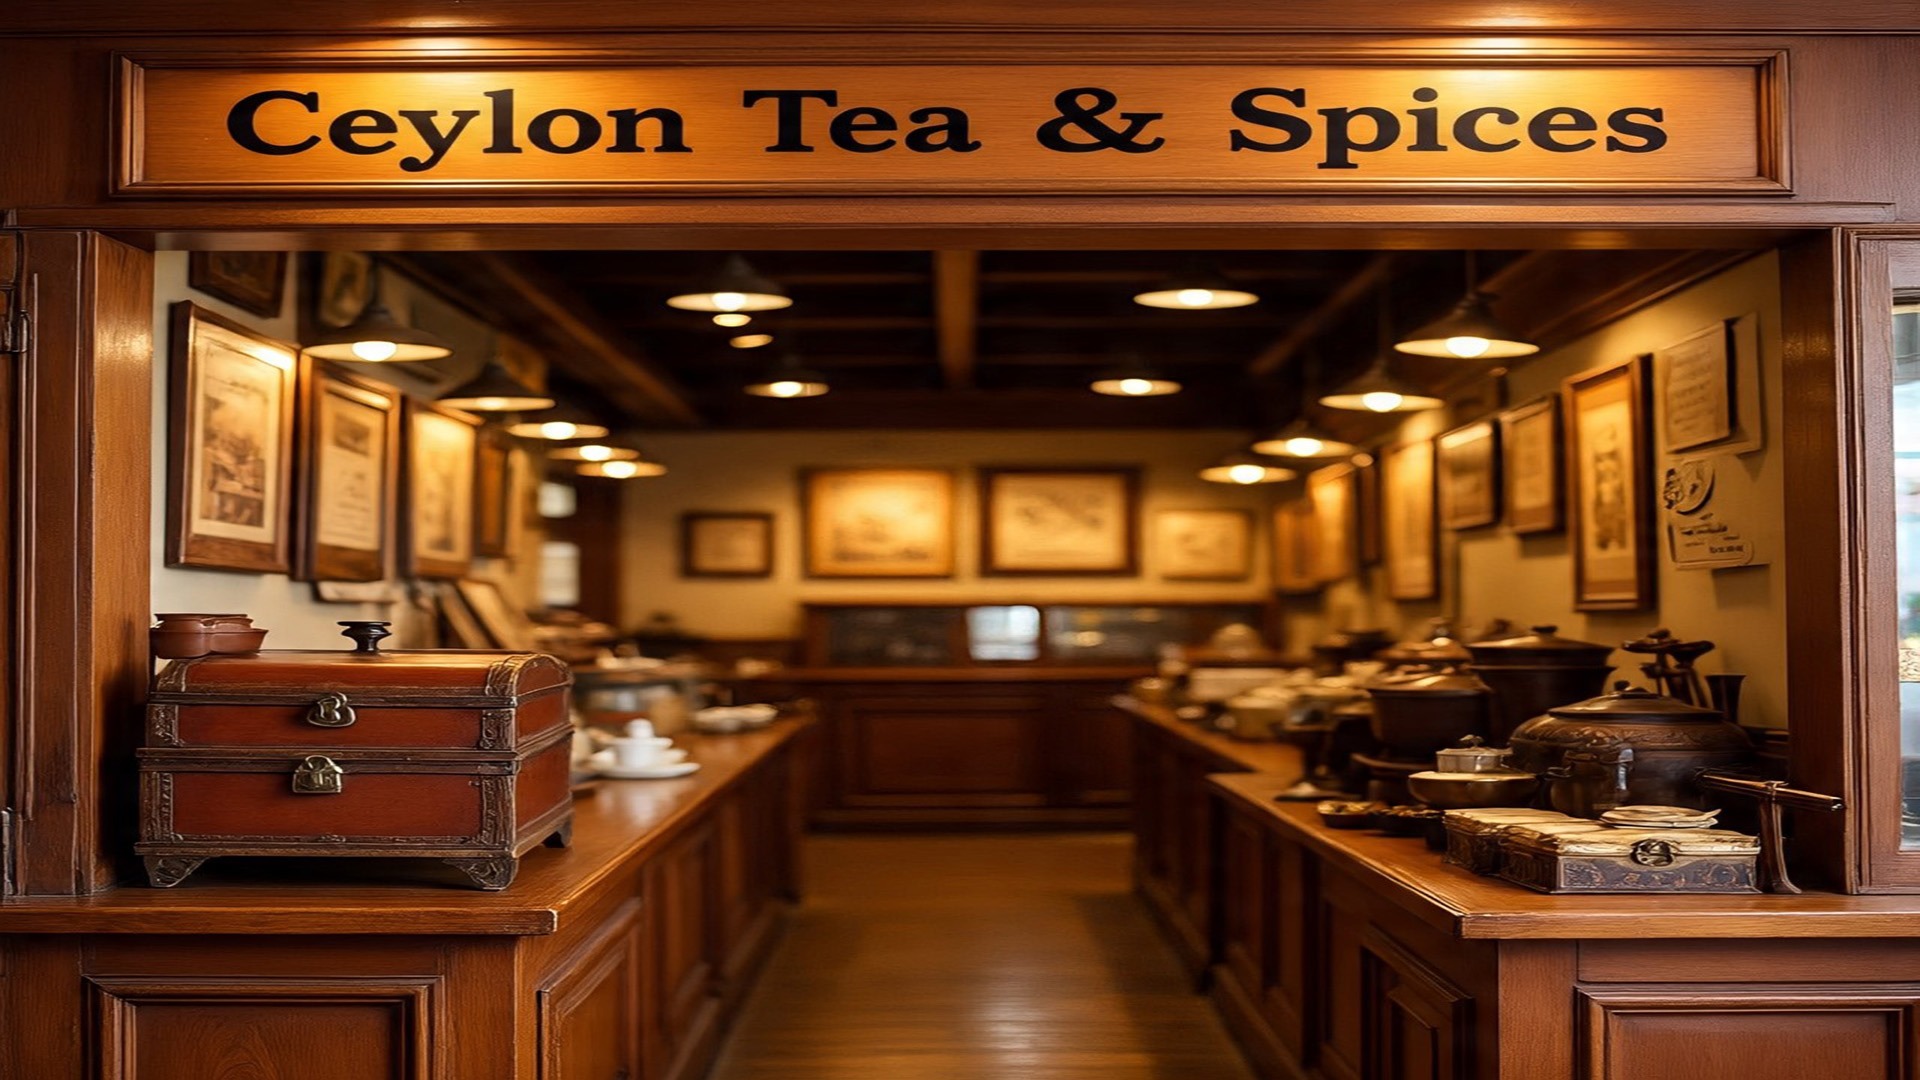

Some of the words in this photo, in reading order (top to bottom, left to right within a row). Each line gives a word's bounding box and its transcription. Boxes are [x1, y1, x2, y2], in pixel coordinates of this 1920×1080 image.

[227, 87, 693, 172] Ceylon
[743, 88, 982, 154] Tea
[1036, 86, 1166, 154] &
[1229, 87, 1668, 169] Spices
